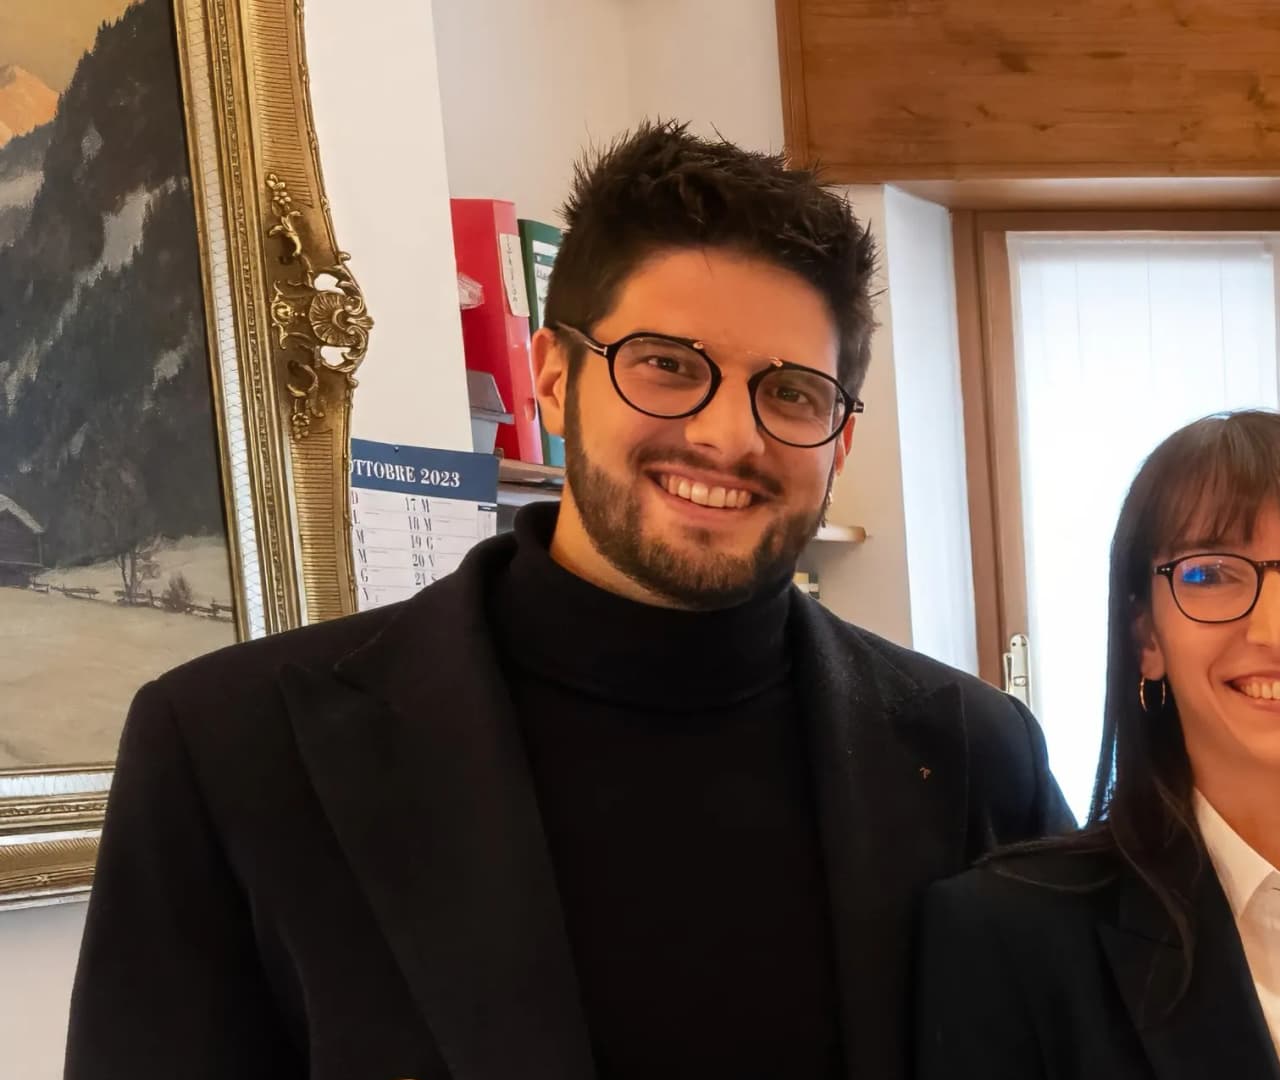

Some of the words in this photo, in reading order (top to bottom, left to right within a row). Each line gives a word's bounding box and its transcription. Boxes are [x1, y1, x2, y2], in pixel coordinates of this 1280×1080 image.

[420, 469, 460, 488] 2023
[405, 497, 416, 511] 17
[421, 498, 430, 512] M
[353, 509, 361, 524] L
[423, 517, 432, 531] M
[411, 535, 421, 548] 19
[411, 554, 425, 567] 20
